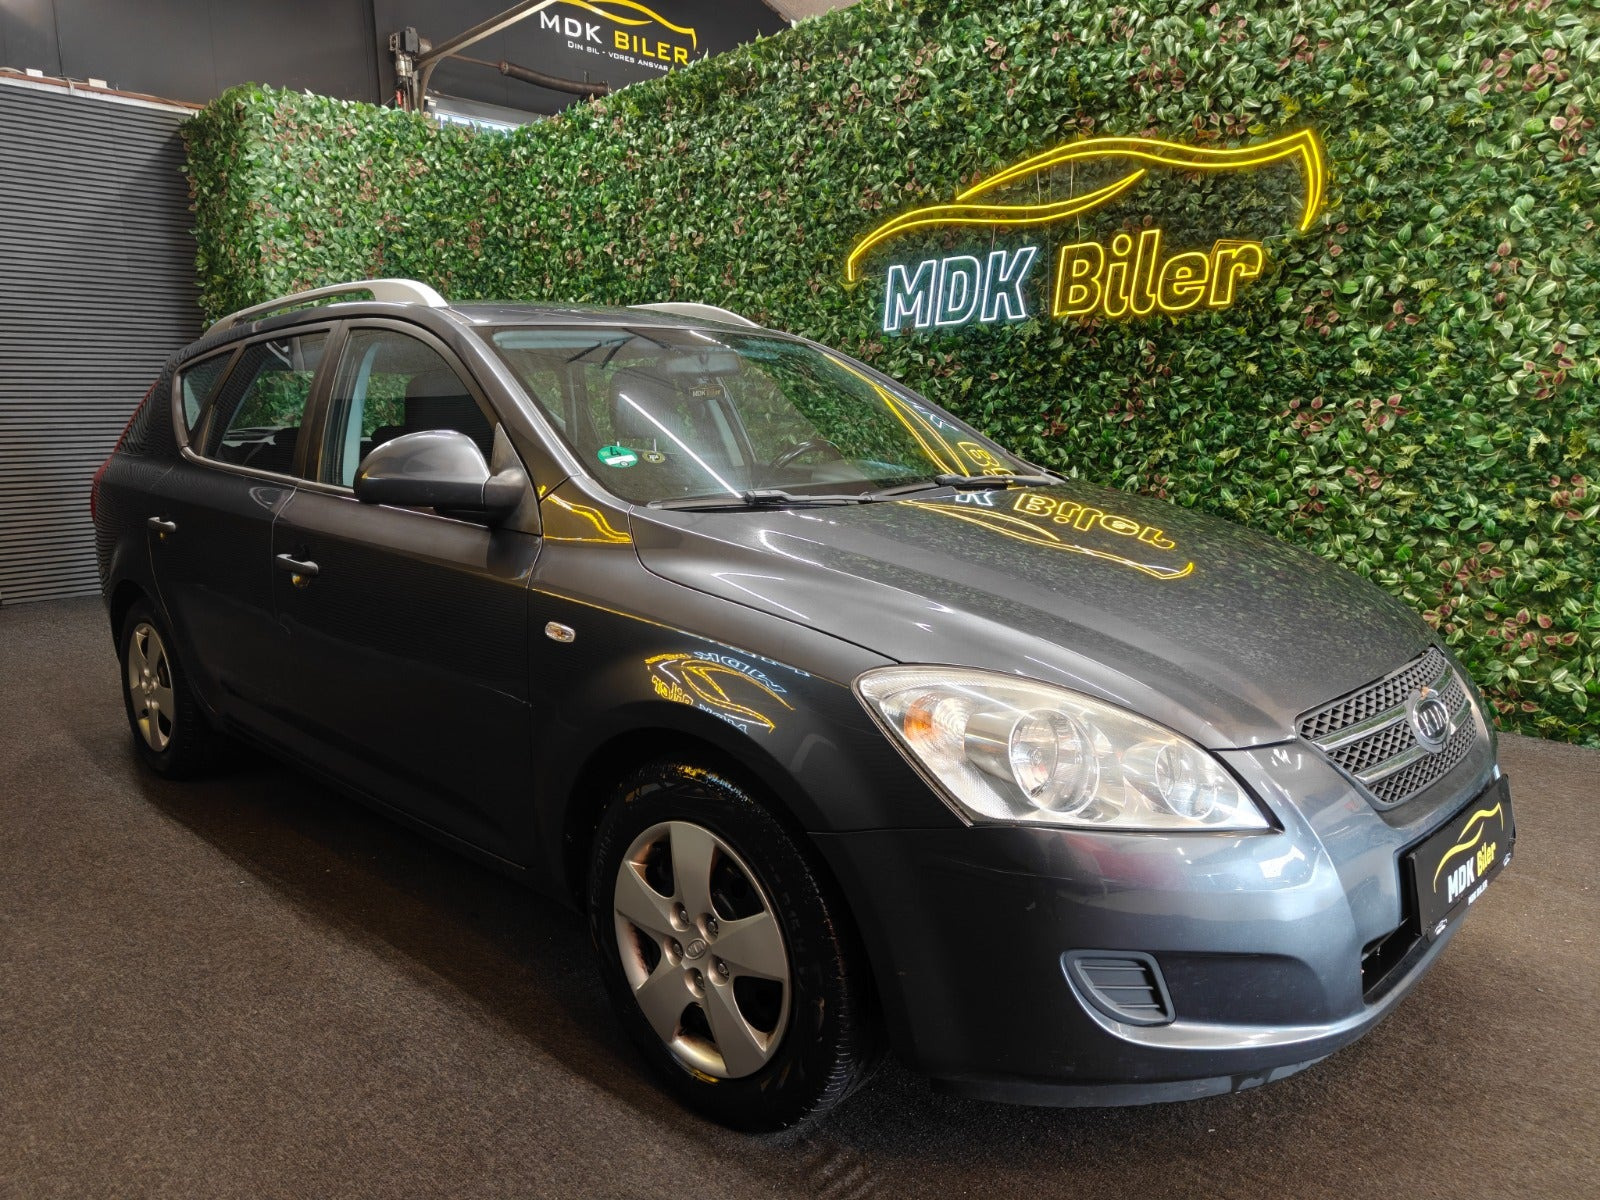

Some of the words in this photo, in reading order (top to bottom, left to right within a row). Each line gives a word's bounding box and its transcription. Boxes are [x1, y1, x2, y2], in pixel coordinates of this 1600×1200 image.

[540, 10, 602, 44] MDK
[614, 30, 689, 65] BILER
[567, 40, 584, 51] DIN
[586, 46, 600, 55] BIL
[608, 51, 635, 64] VORES
[637, 59, 669, 72] ANSVAR
[883, 245, 1037, 332] MDK
[1054, 229, 1263, 318] Biler
[1447, 856, 1475, 904] MDK
[1476, 842, 1497, 877] Biler
